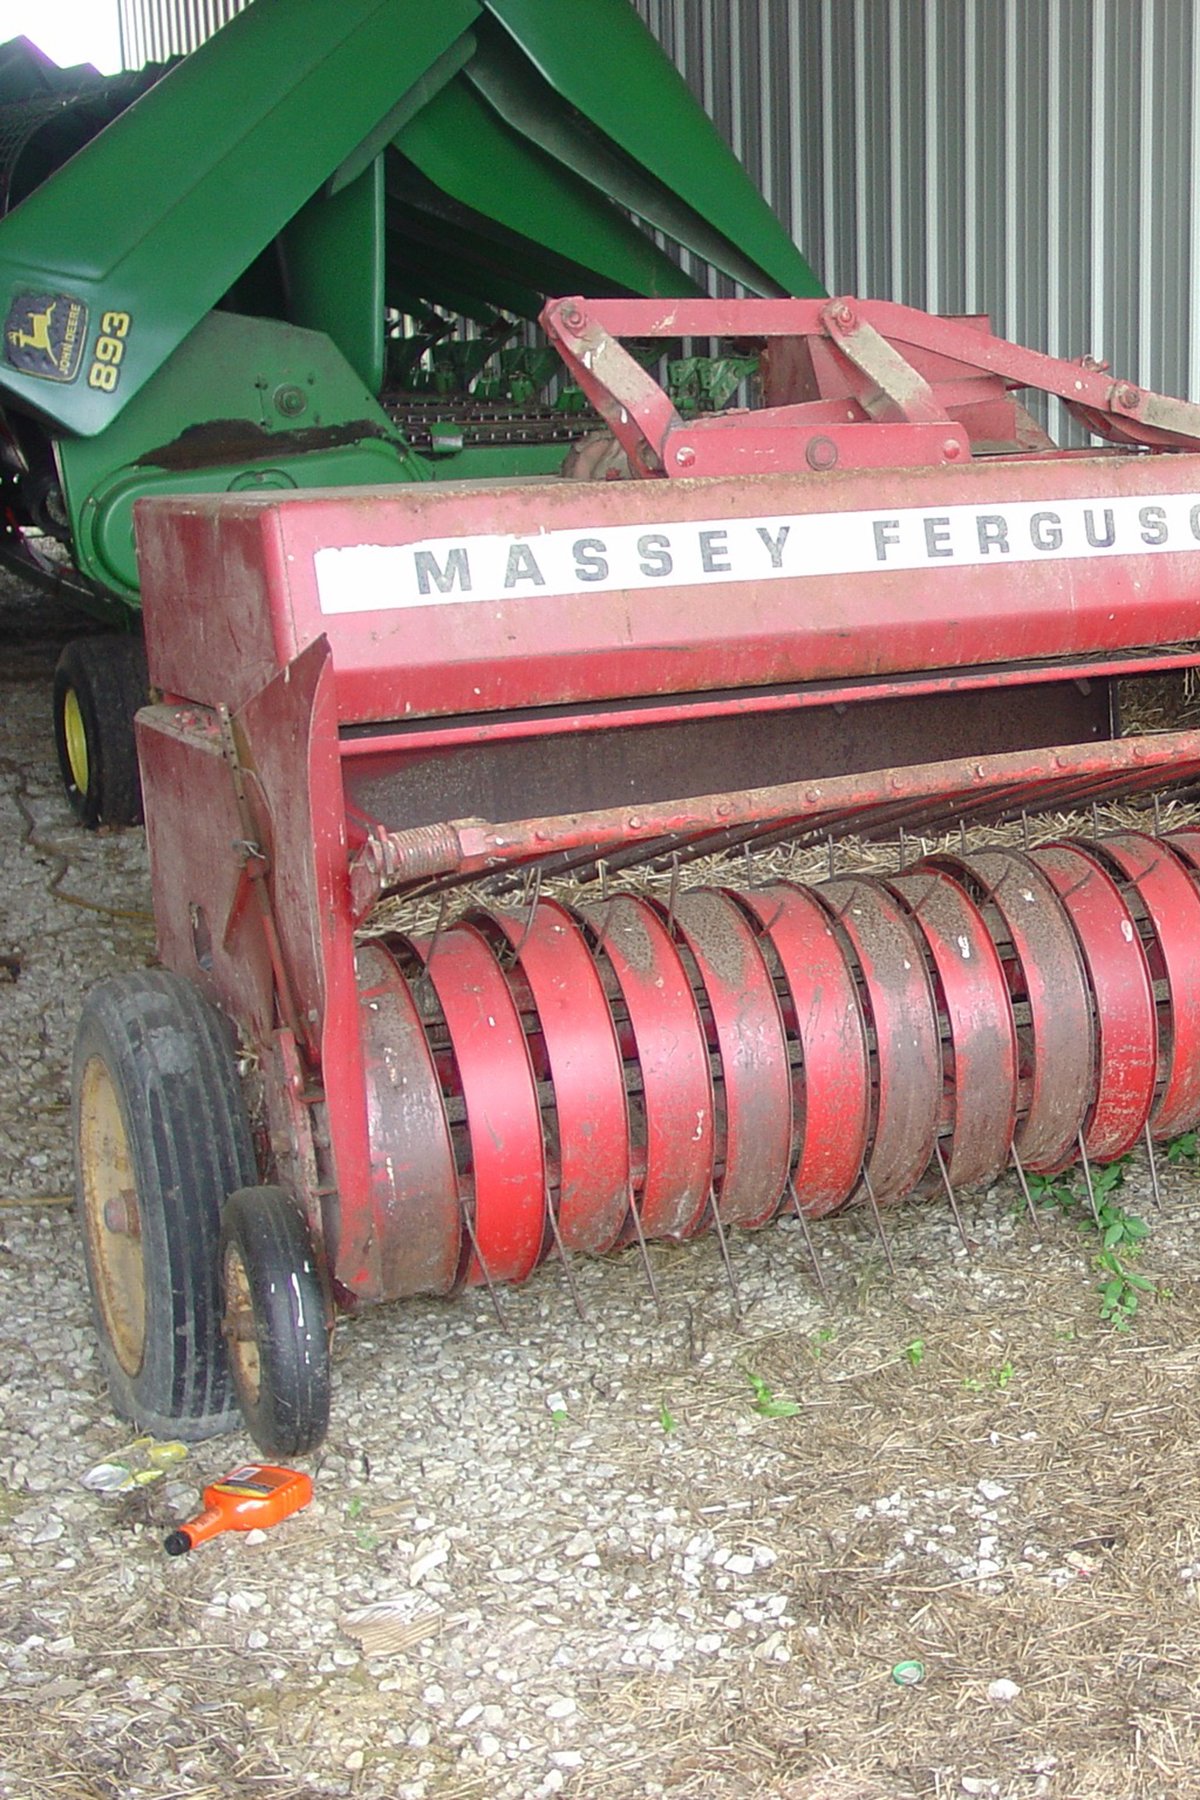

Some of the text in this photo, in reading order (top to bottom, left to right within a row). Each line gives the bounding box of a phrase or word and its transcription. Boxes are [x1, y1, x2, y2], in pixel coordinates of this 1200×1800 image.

[59, 303, 81, 375] JOHN DEERE
[89, 312, 130, 391] 893
[414, 526, 791, 595] MASSEY
